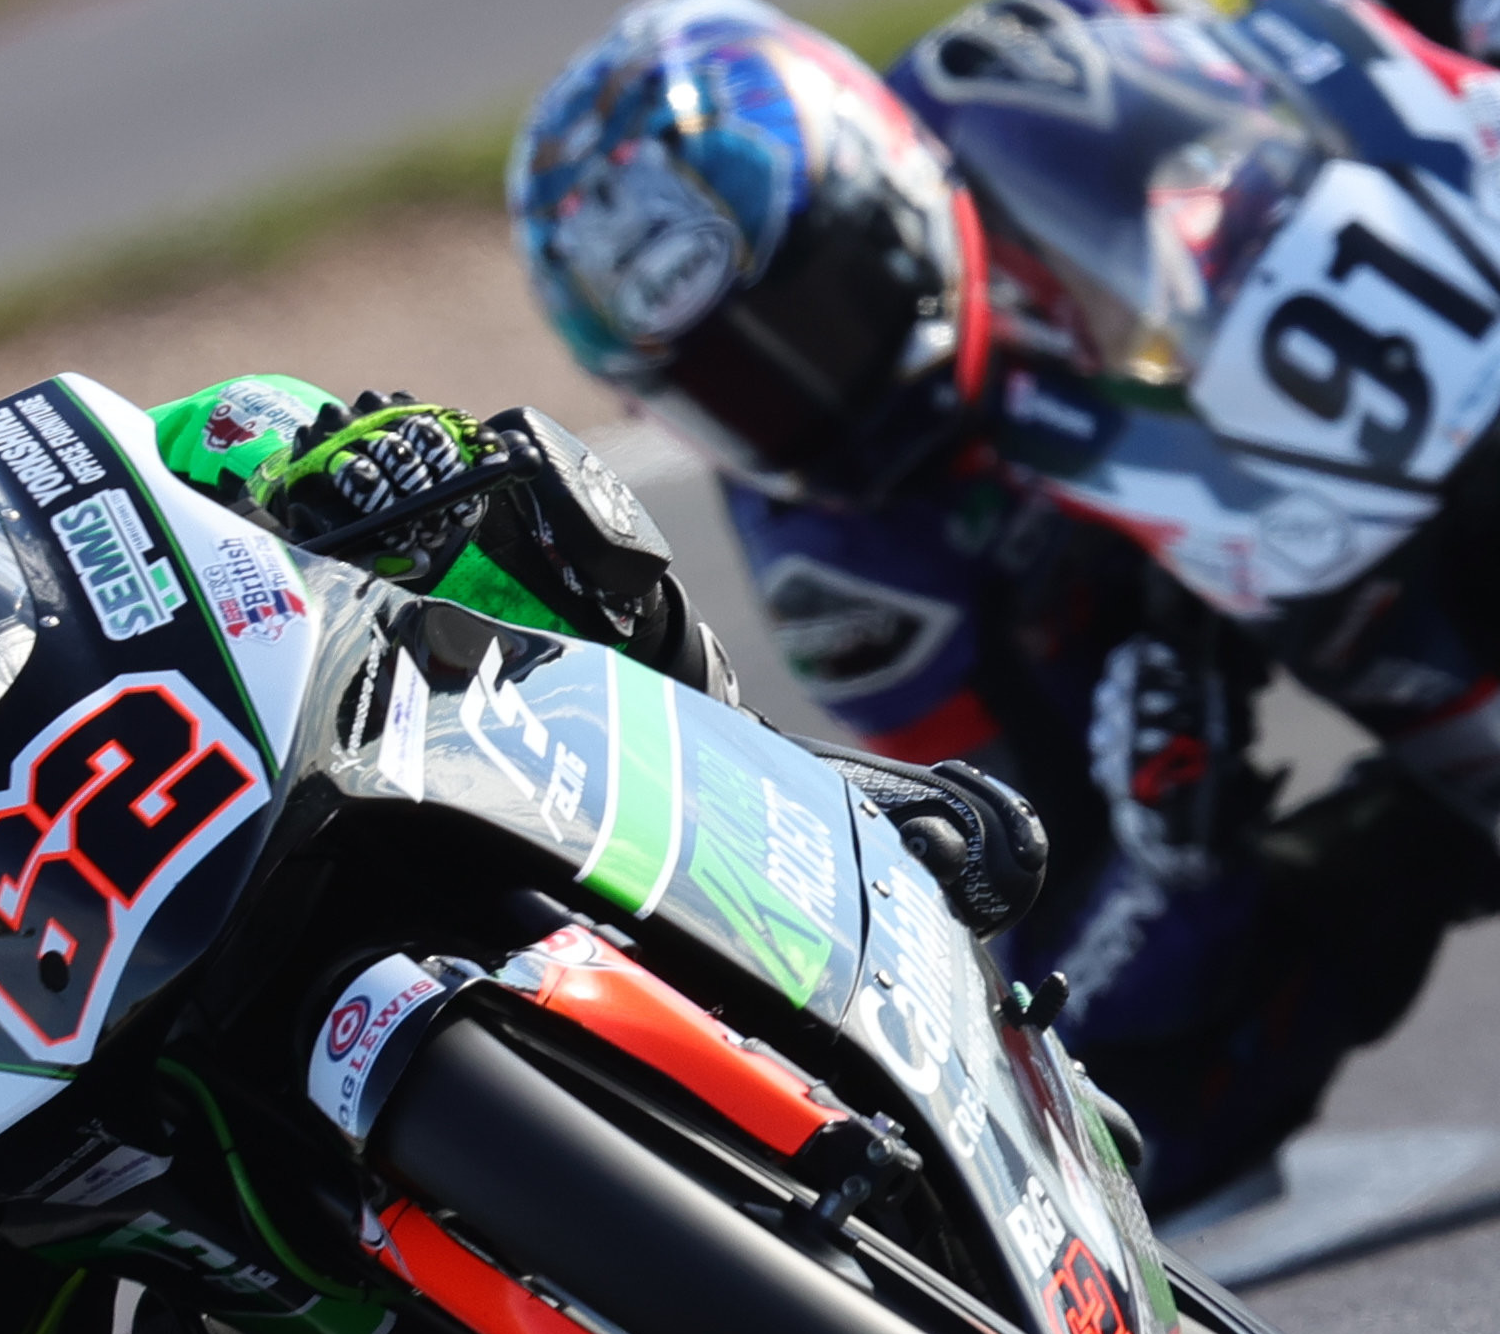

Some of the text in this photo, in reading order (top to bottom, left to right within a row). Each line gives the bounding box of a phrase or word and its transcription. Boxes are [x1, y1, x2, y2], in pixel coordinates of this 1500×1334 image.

[14, 393, 107, 485] OFFICE FURNITURE
[58, 501, 154, 635] SEMMS
[218, 537, 268, 607] British
[540, 741, 588, 843] racing
[759, 776, 837, 937] PROJECTS
[350, 978, 437, 1072] LEWIS
